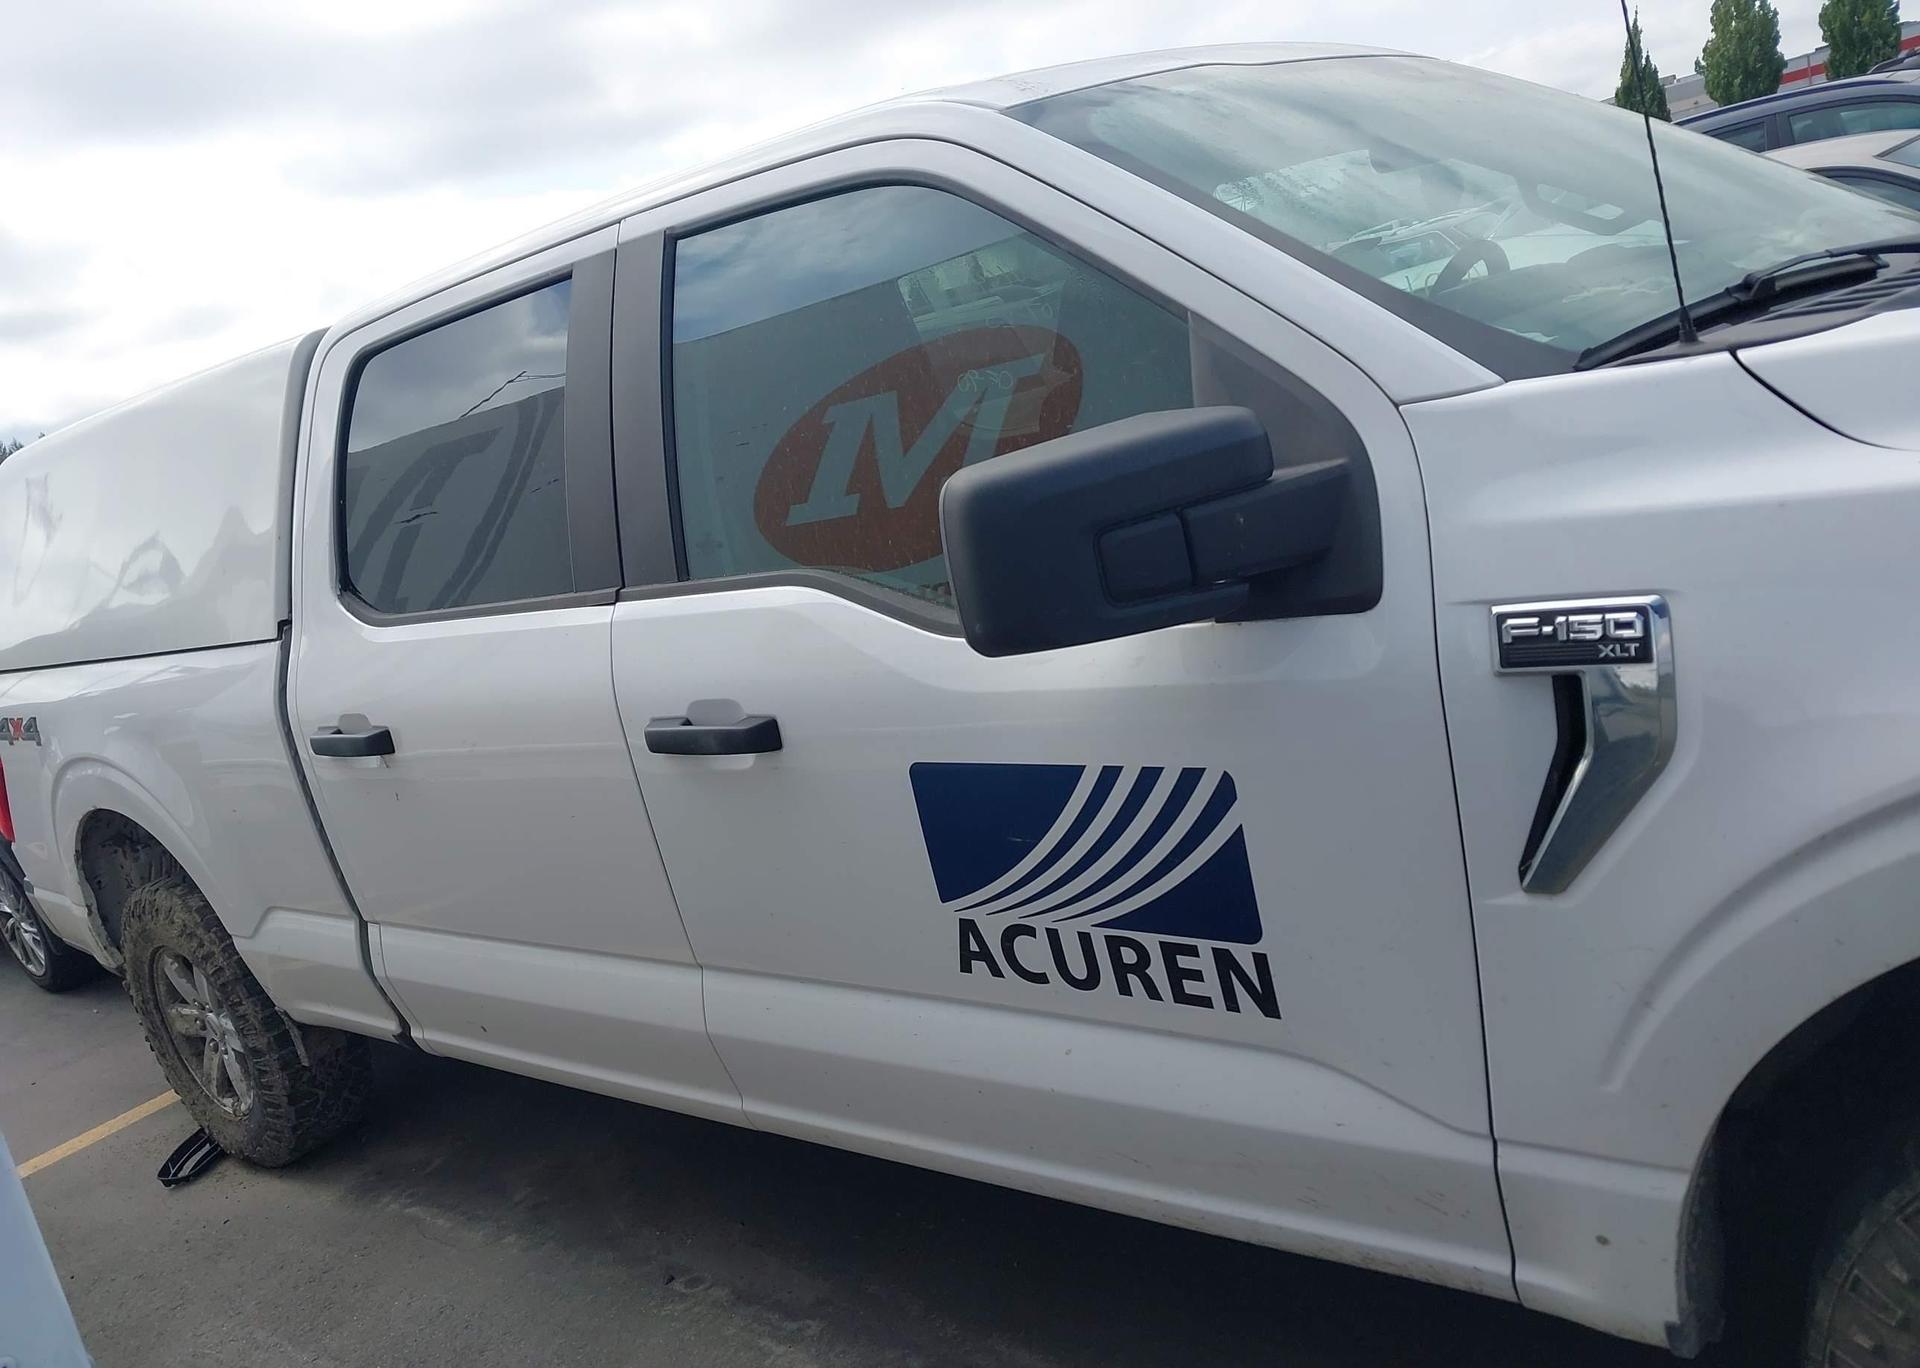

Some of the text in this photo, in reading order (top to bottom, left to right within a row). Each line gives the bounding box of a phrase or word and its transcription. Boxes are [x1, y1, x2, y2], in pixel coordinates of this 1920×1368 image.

[1501, 611, 1646, 644] F-150
[1597, 643, 1641, 658] XLT
[958, 917, 1283, 1020] ACUREN
